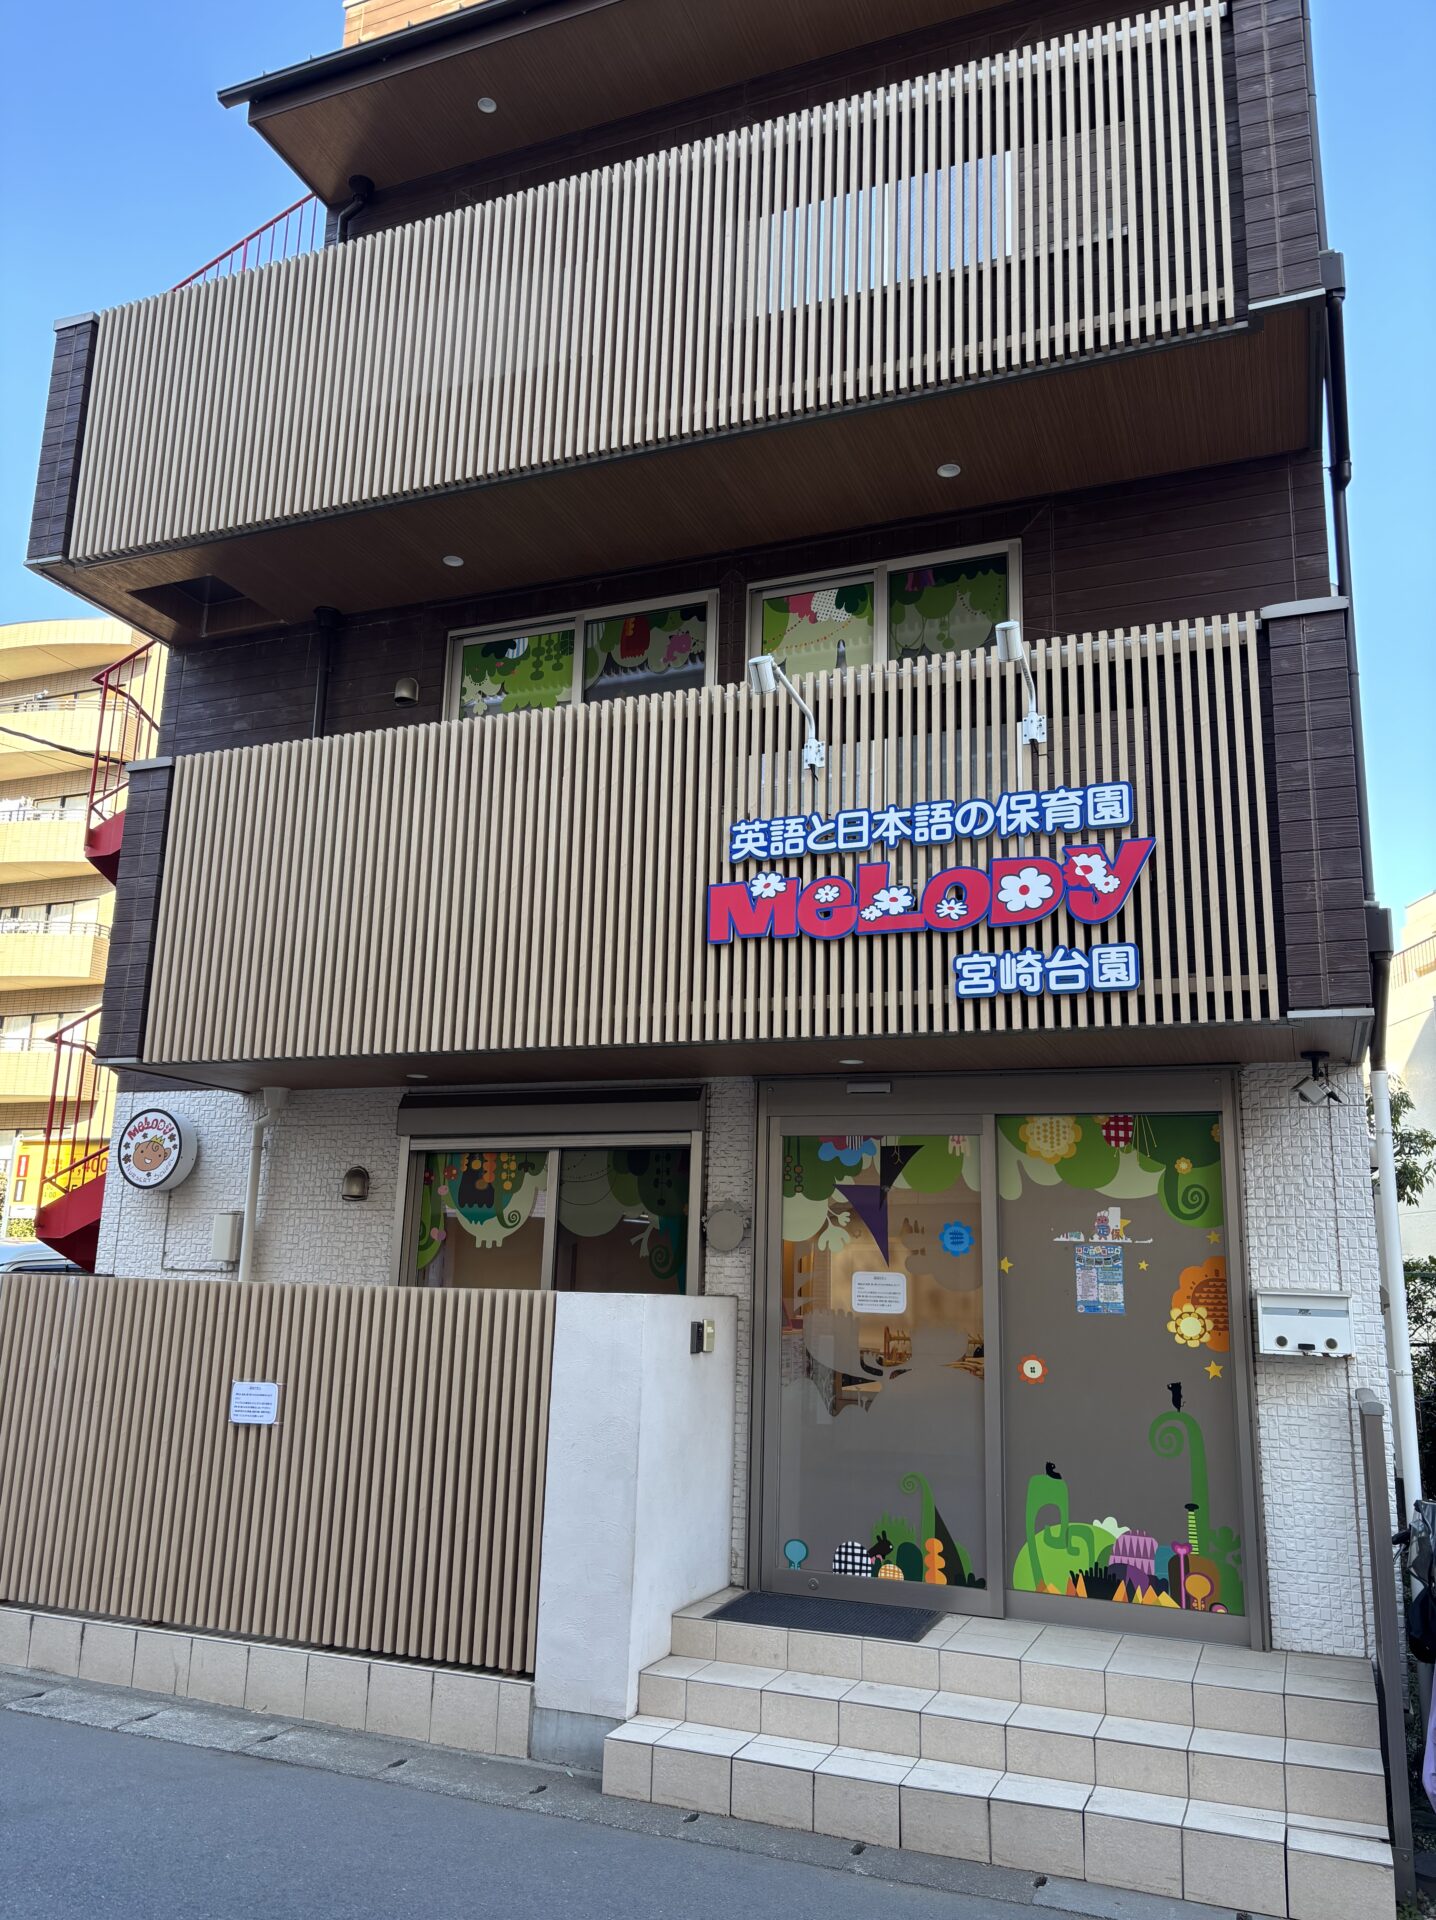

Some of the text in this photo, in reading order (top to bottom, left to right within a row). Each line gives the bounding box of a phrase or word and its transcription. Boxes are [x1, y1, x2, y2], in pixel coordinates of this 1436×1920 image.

[730, 782, 1134, 861] 英語と日本語の保育園
[953, 943, 1140, 998] 宮崎台園
